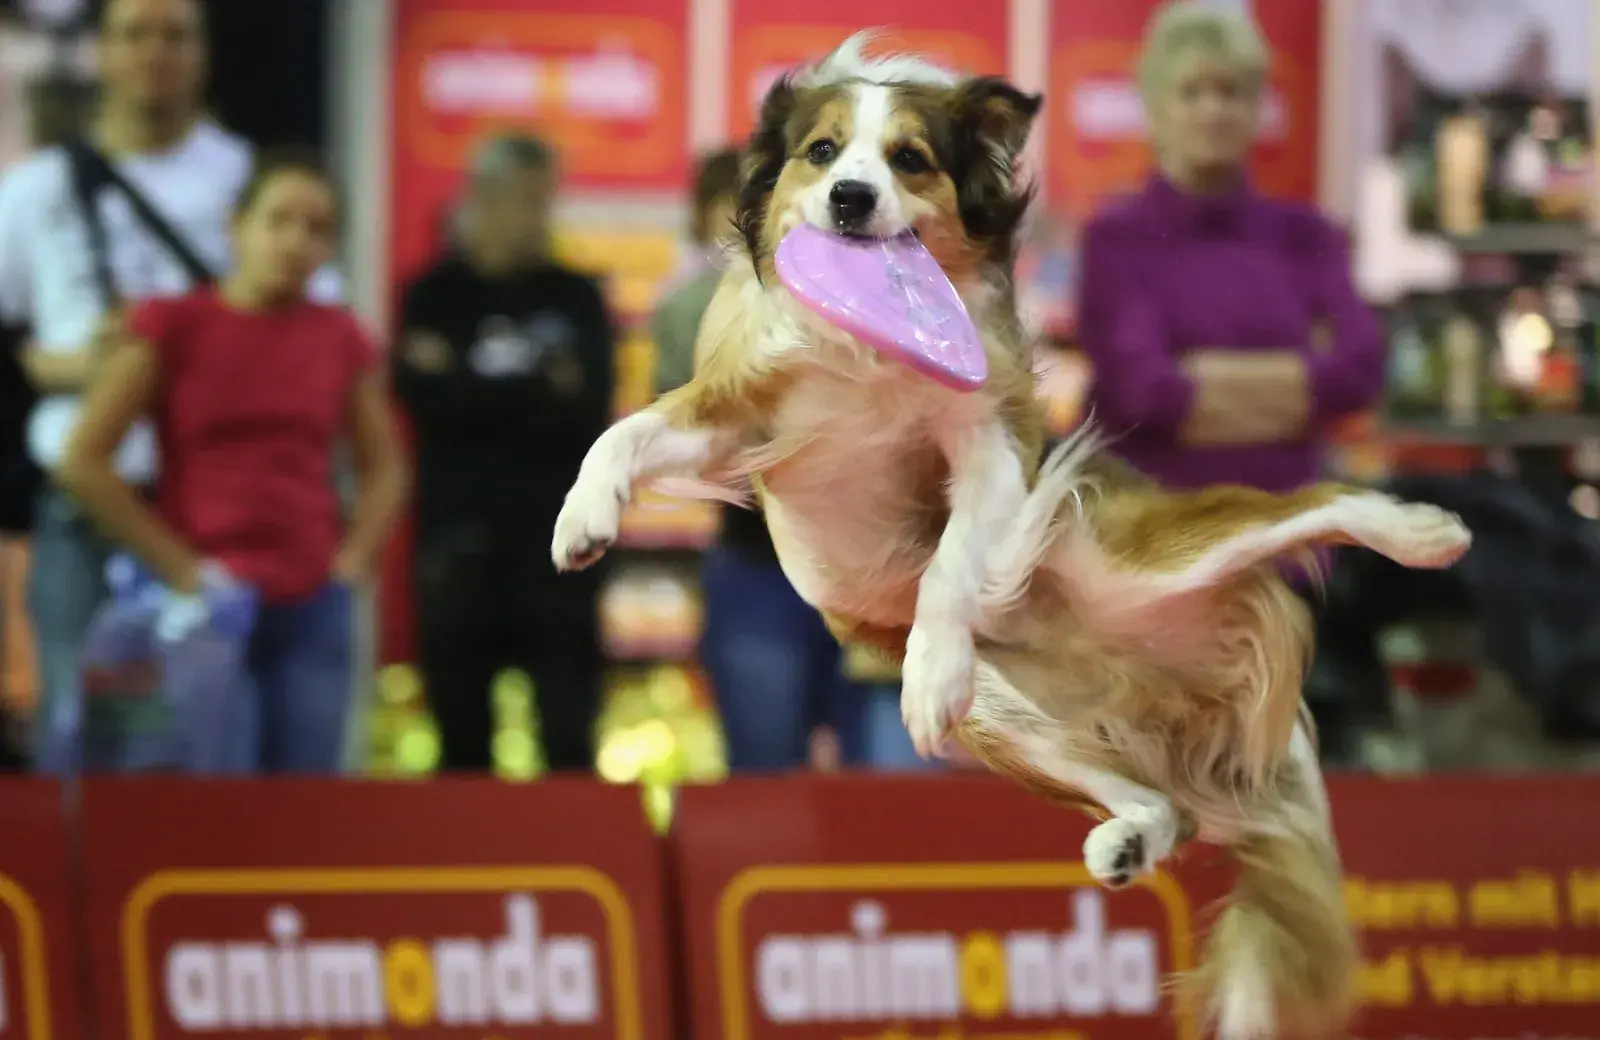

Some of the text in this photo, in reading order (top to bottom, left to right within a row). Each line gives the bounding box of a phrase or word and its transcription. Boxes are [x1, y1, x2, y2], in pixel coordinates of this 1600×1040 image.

[165, 893, 596, 1028] animonda
[758, 889, 1158, 1023] animonda
[1421, 946, 1600, 1006] Versta
